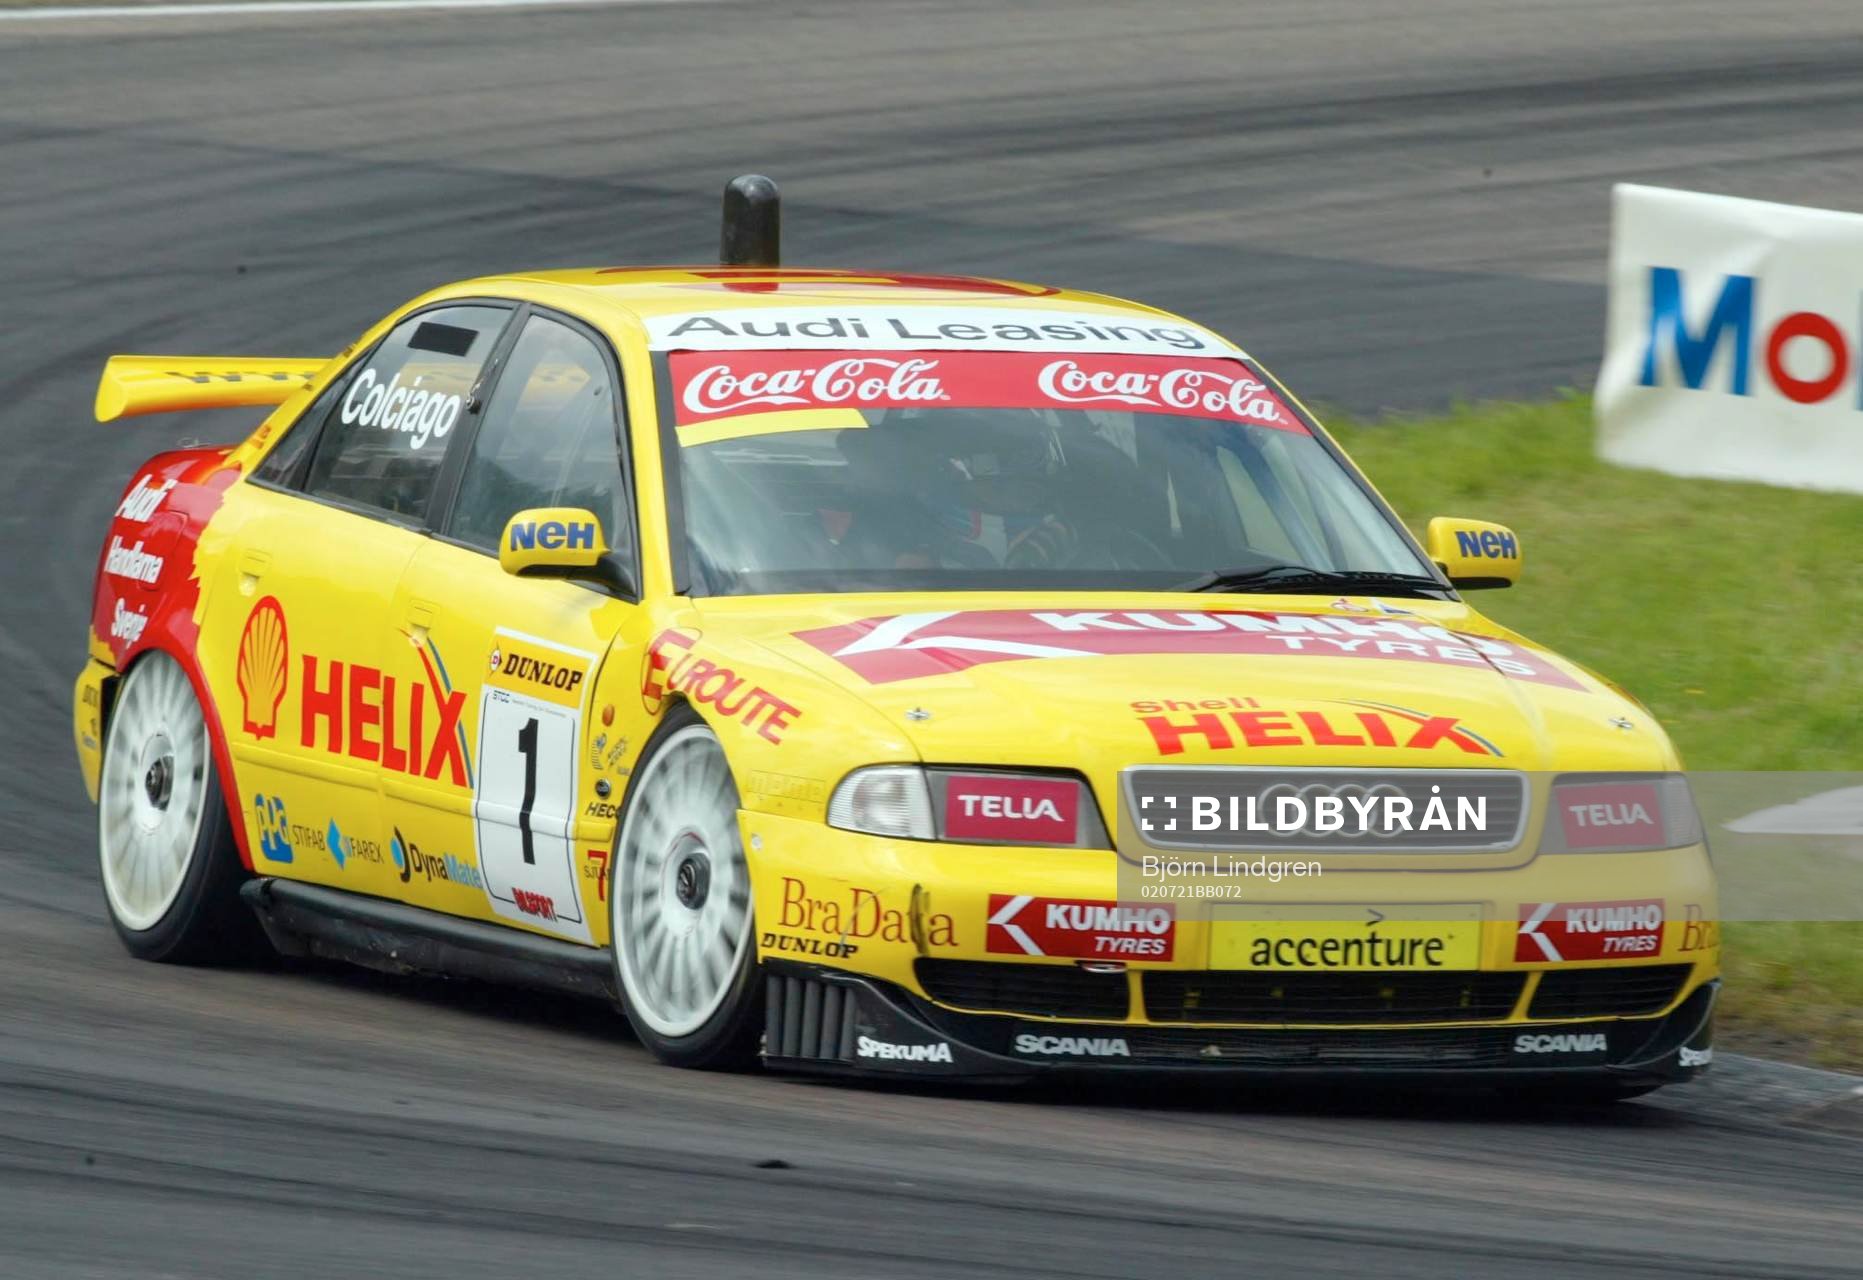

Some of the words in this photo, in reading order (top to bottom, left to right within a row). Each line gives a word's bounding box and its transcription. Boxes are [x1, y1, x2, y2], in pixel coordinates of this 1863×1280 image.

[667, 317, 870, 338] Audi
[886, 318, 1206, 350] Leasing
[1637, 265, 1863, 412] Mo
[683, 359, 944, 413] Coca-Cola
[1038, 360, 1281, 421] Coca-Cola
[341, 368, 461, 449] Colciago
[114, 474, 177, 522] Audi
[510, 521, 595, 552] NeH
[1456, 530, 1518, 560] NeH
[1029, 611, 1513, 657] KUMHO
[1265, 635, 1537, 676] TYRES
[503, 653, 583, 692] DUNLOP
[301, 654, 467, 788] HELIX
[1130, 697, 1261, 714] shell
[1137, 711, 1491, 757] HELIX
[518, 717, 539, 866] 1
[958, 795, 1065, 822] TELIA
[1568, 803, 1656, 827] TELIA
[1045, 903, 1171, 935] KUMHO
[1565, 904, 1661, 934] KUMHO
[760, 932, 858, 958] DUNLOP
[1094, 936, 1167, 955] TYRES
[1249, 931, 1444, 967] accenture
[1603, 936, 1658, 953] TYRES
[1015, 1034, 1131, 1057] SCANIA
[1513, 1033, 1608, 1053] SCANIA
